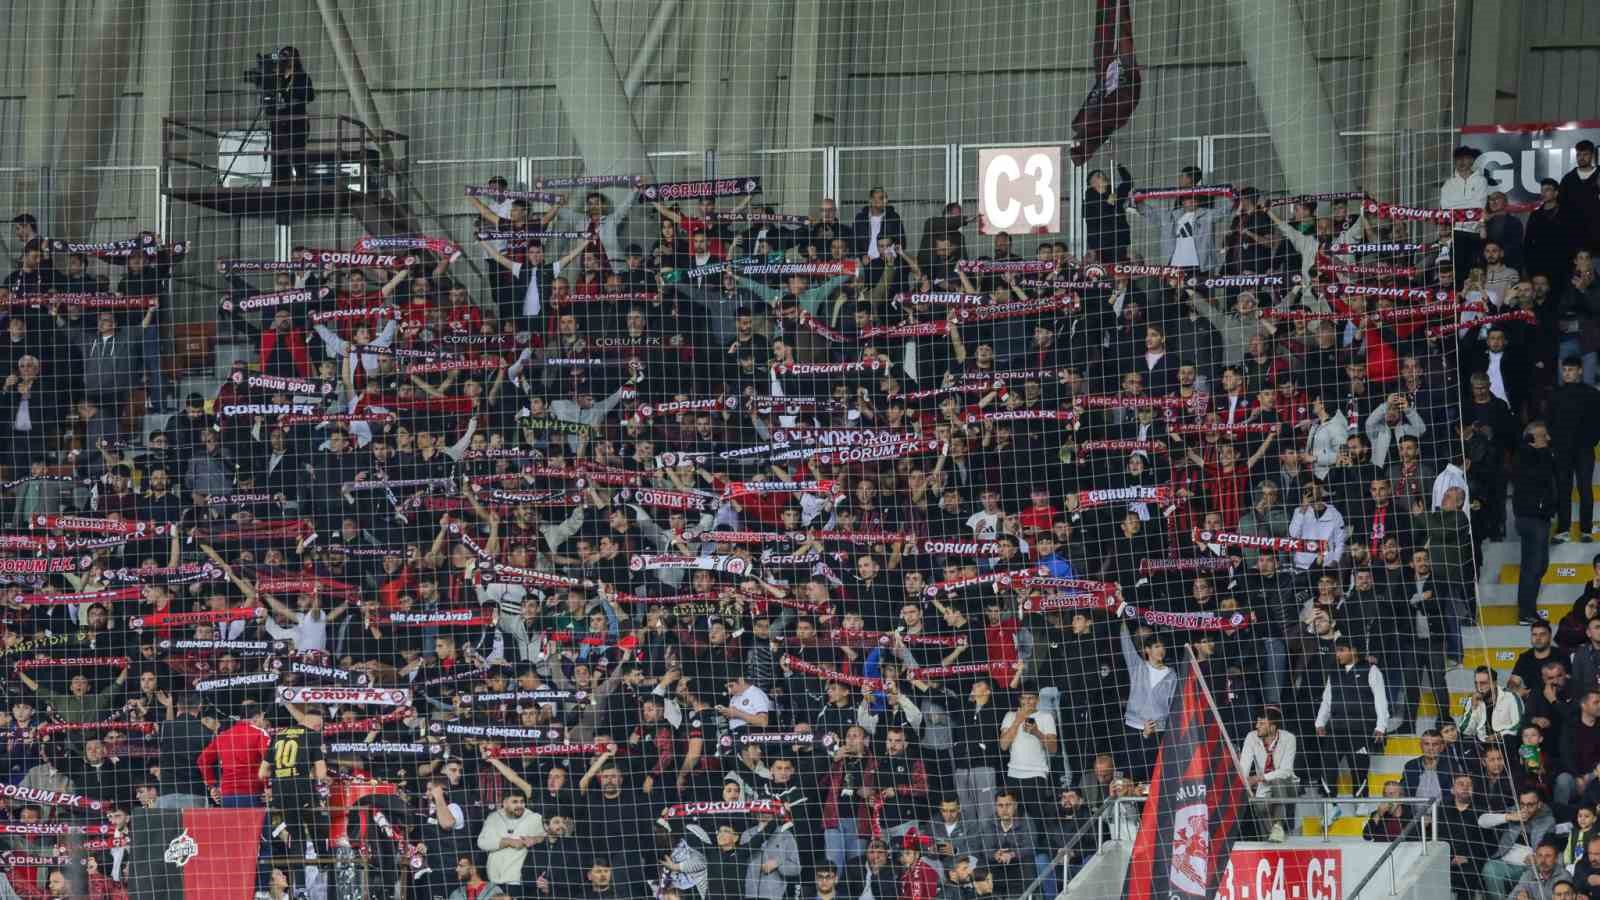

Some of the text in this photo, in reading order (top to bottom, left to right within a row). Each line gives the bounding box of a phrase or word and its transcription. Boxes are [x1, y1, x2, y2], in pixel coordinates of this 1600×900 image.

[1474, 139, 1577, 194] GÜ
[984, 153, 1055, 228] C3
[378, 256, 397, 266] FK
[283, 292, 312, 304] SPOR
[1408, 288, 1431, 299] FK
[964, 296, 983, 305] FK
[645, 336, 661, 346] FK
[847, 361, 865, 372] FK
[288, 381, 316, 393] SPOR
[293, 405, 315, 415] FK
[899, 440, 920, 453] FK
[1279, 538, 1300, 549] FK
[333, 669, 349, 680] FK
[364, 692, 385, 702] FK
[447, 725, 541, 740] KIRMIZI ŞİMŞEKLER
[274, 740, 298, 766] 10
[58, 792, 82, 807] FK
[1256, 858, 1286, 900] C4
[1307, 858, 1338, 900] C5
